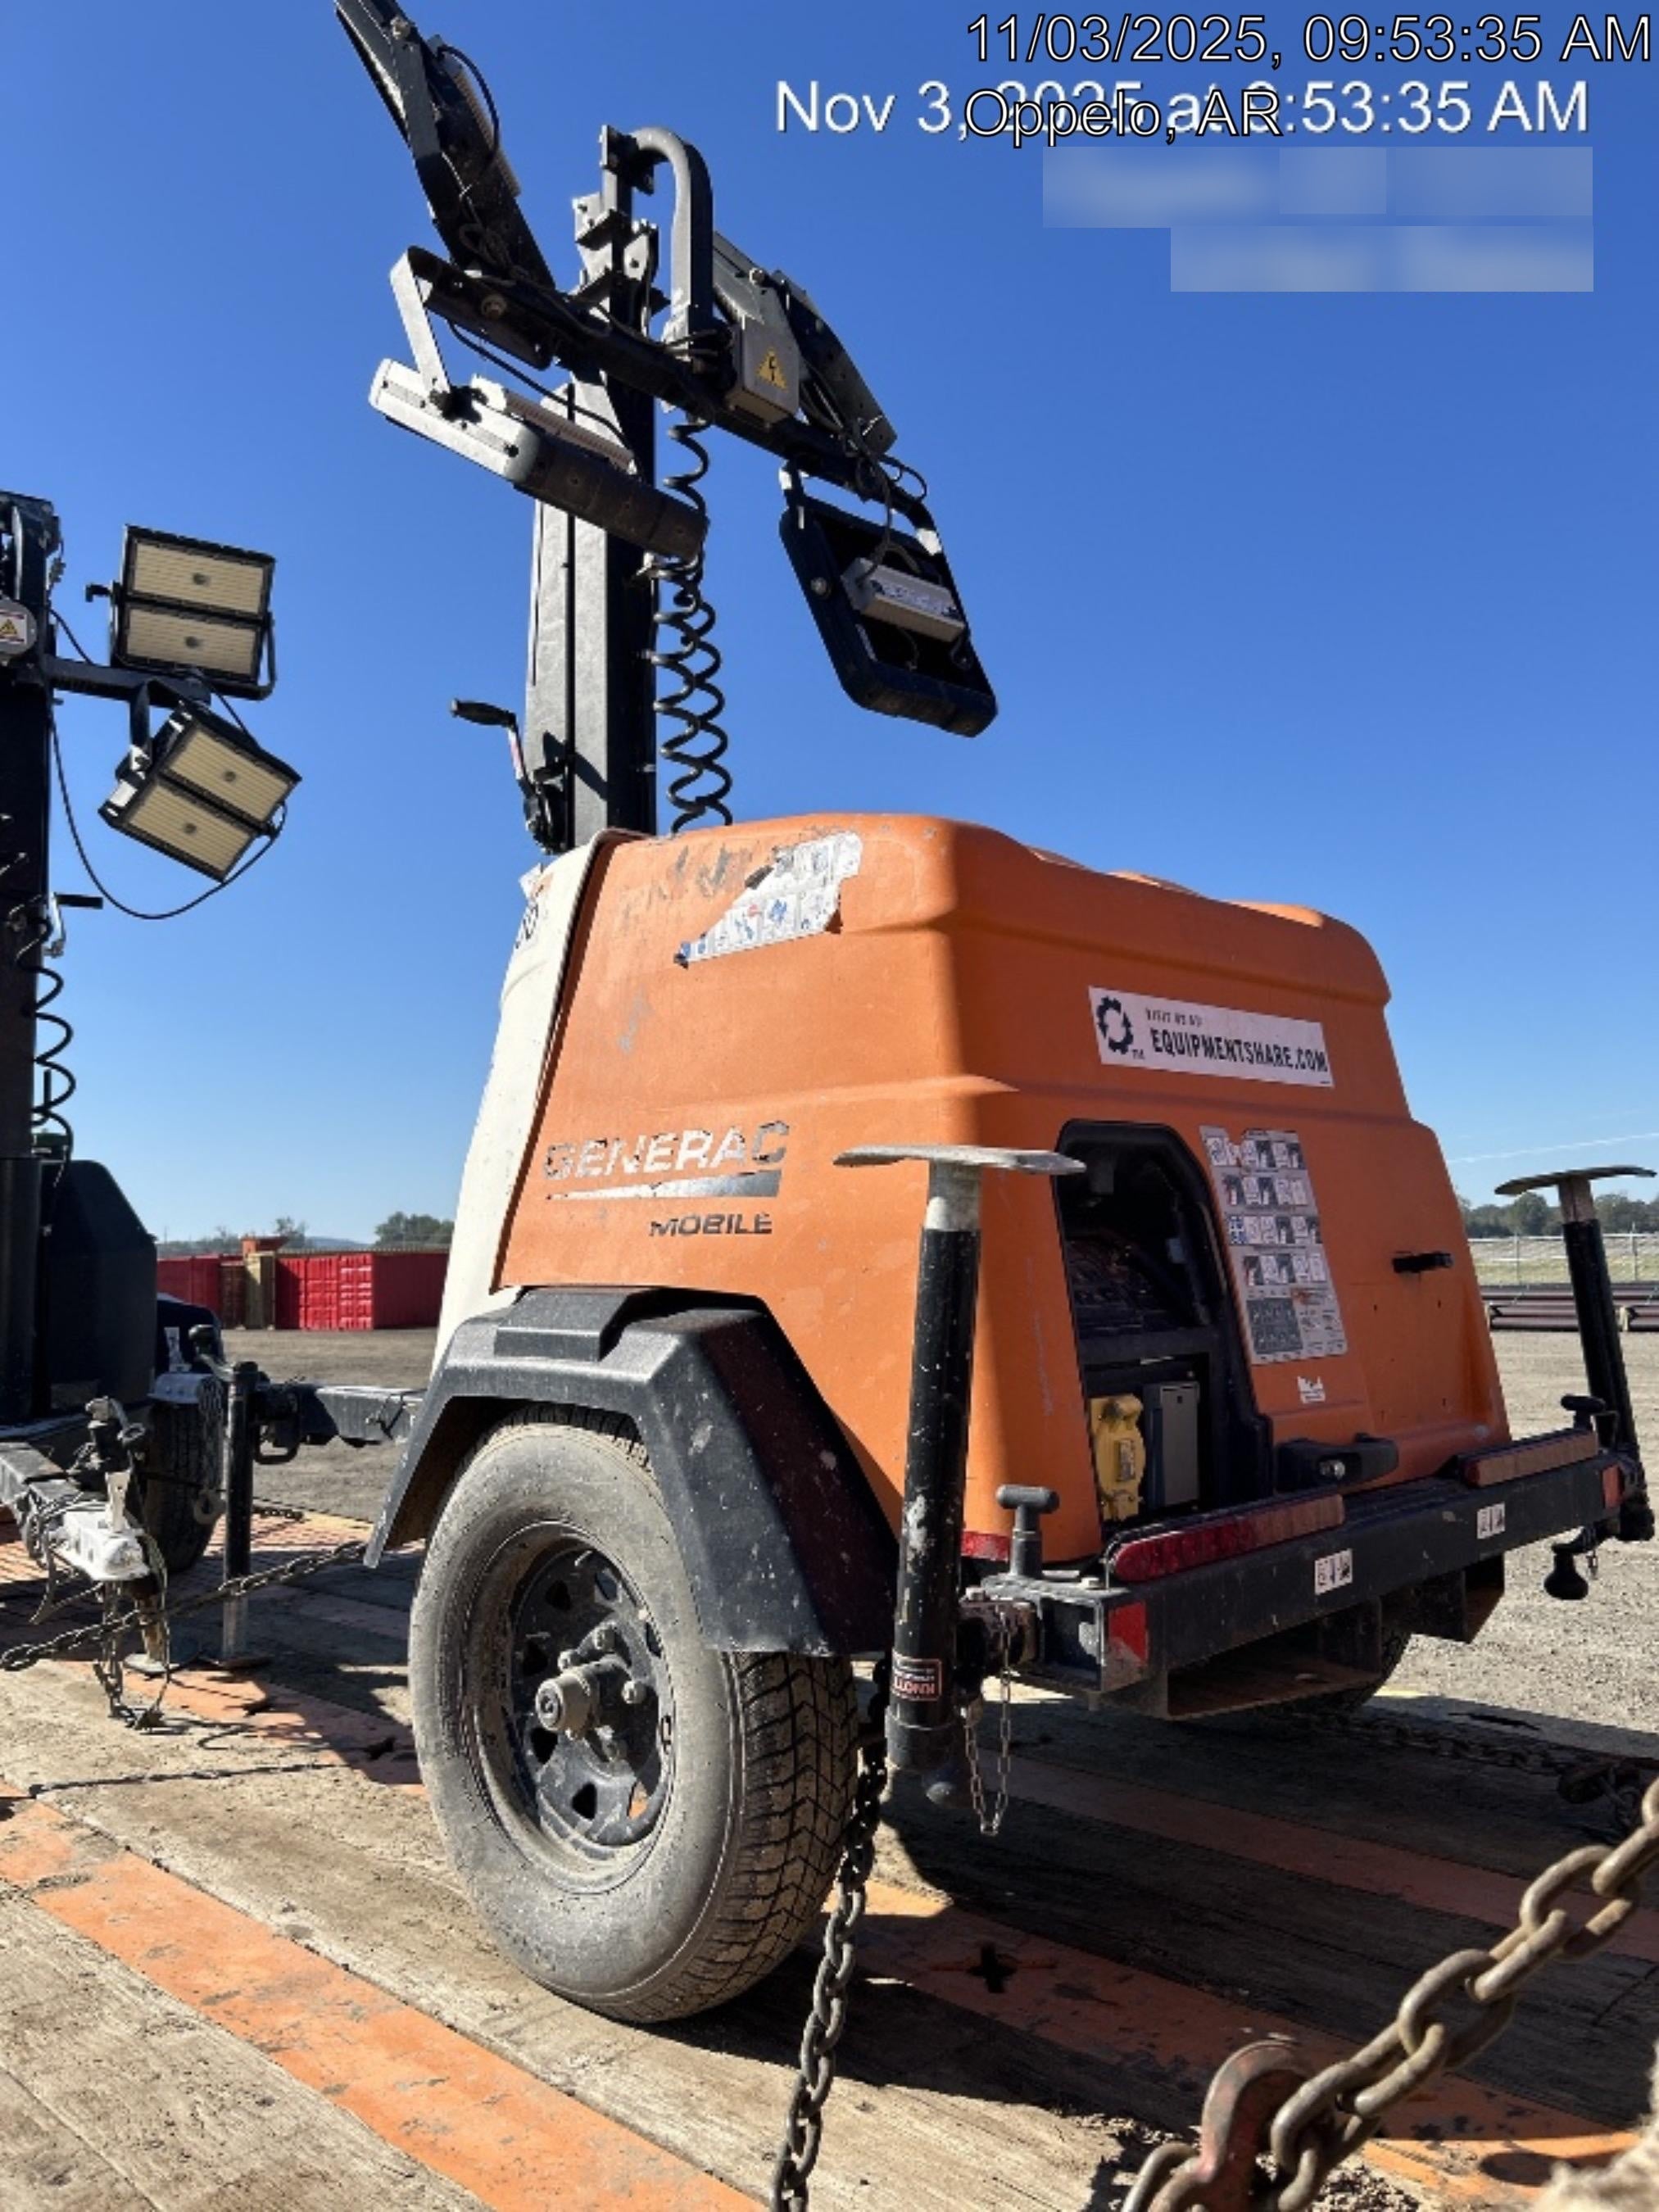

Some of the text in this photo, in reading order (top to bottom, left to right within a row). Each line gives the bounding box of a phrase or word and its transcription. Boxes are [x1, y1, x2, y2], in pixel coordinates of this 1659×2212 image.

[1149, 1027, 1329, 1072] EQUIPMENTSHARE.COM
[543, 1121, 791, 1181] GENERAC
[649, 1213, 773, 1237] MOBILE
